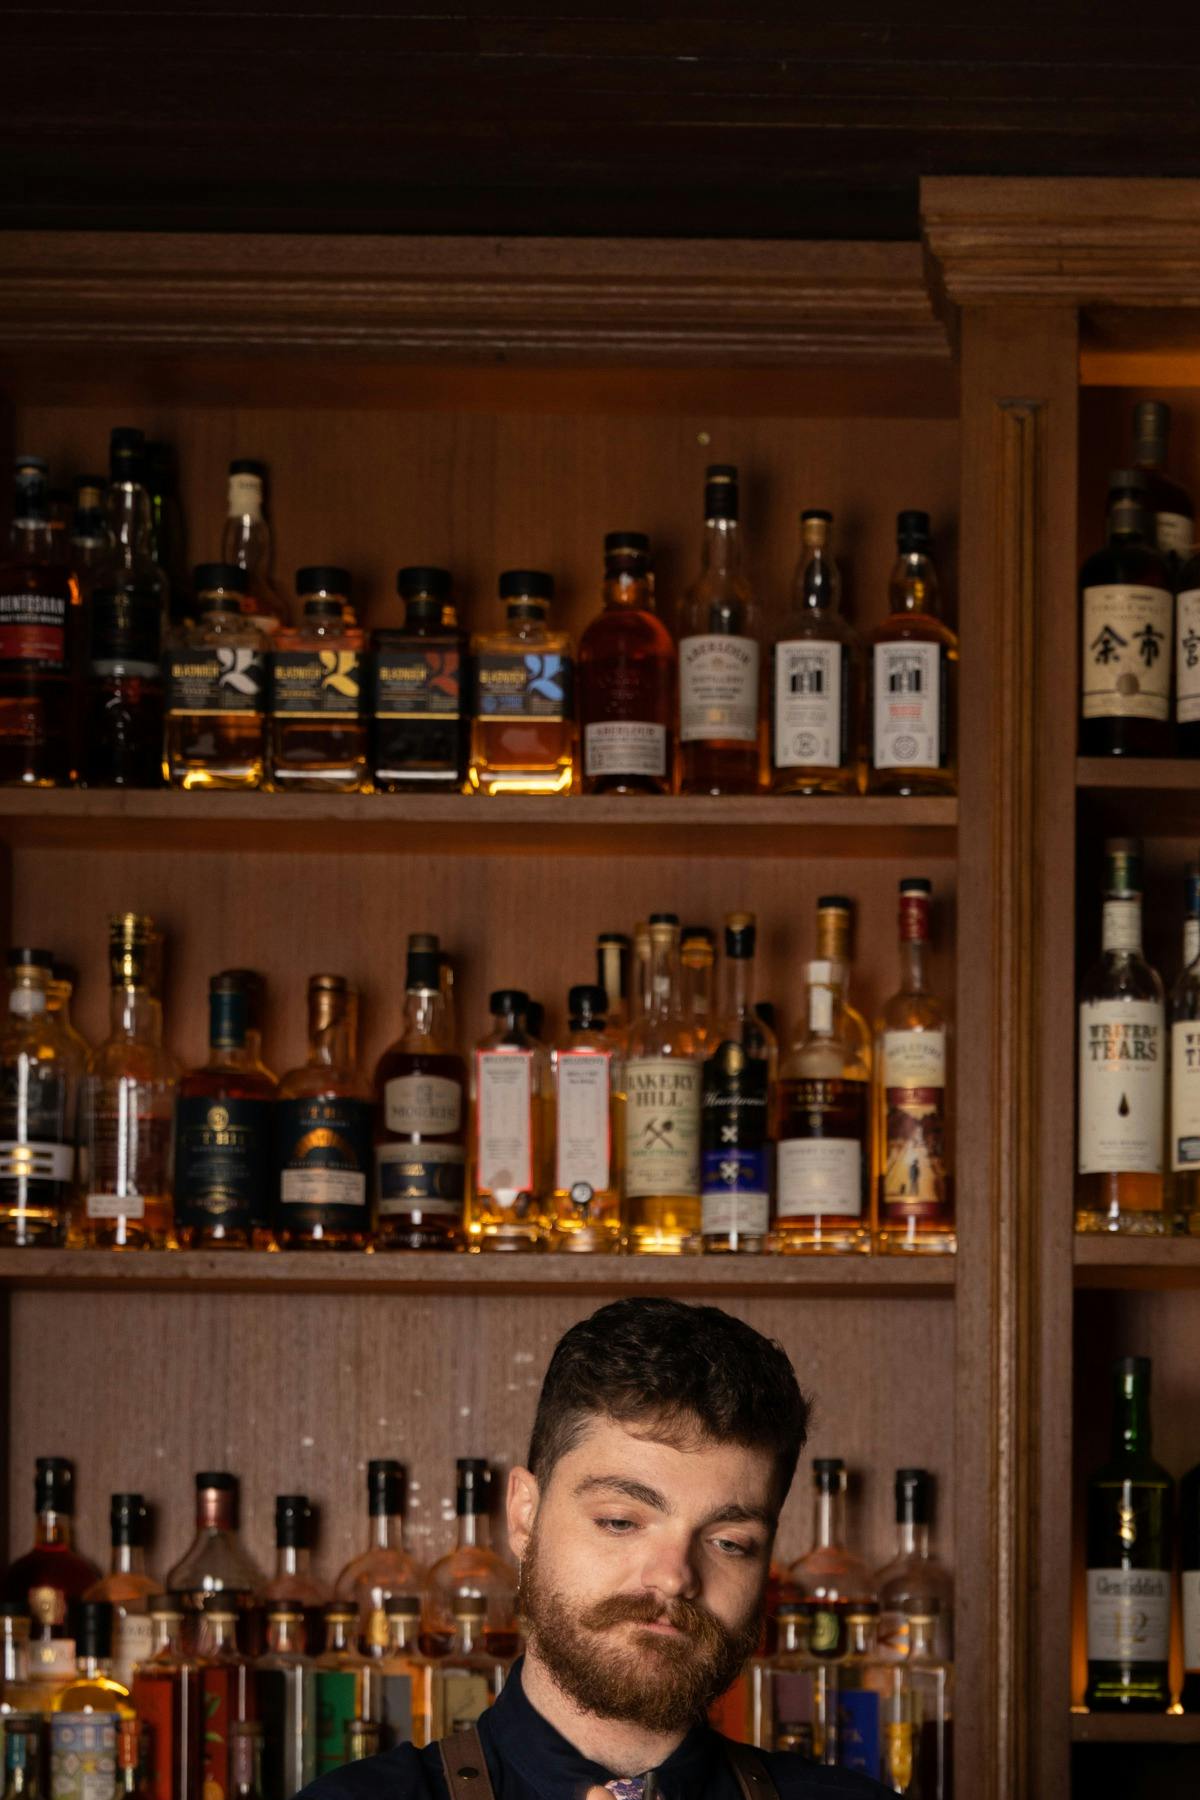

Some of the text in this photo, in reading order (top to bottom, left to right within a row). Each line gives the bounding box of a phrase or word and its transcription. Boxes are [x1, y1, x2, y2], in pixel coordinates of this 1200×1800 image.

[1090, 622, 1165, 668] 余市
[1088, 1040, 1159, 1061] TEARS
[627, 1073, 697, 1091] BAKERY
[636, 1091, 683, 1108] HILL
[1095, 1577, 1165, 1597] Glenfiddich
[1114, 1611, 1147, 1643] 12
